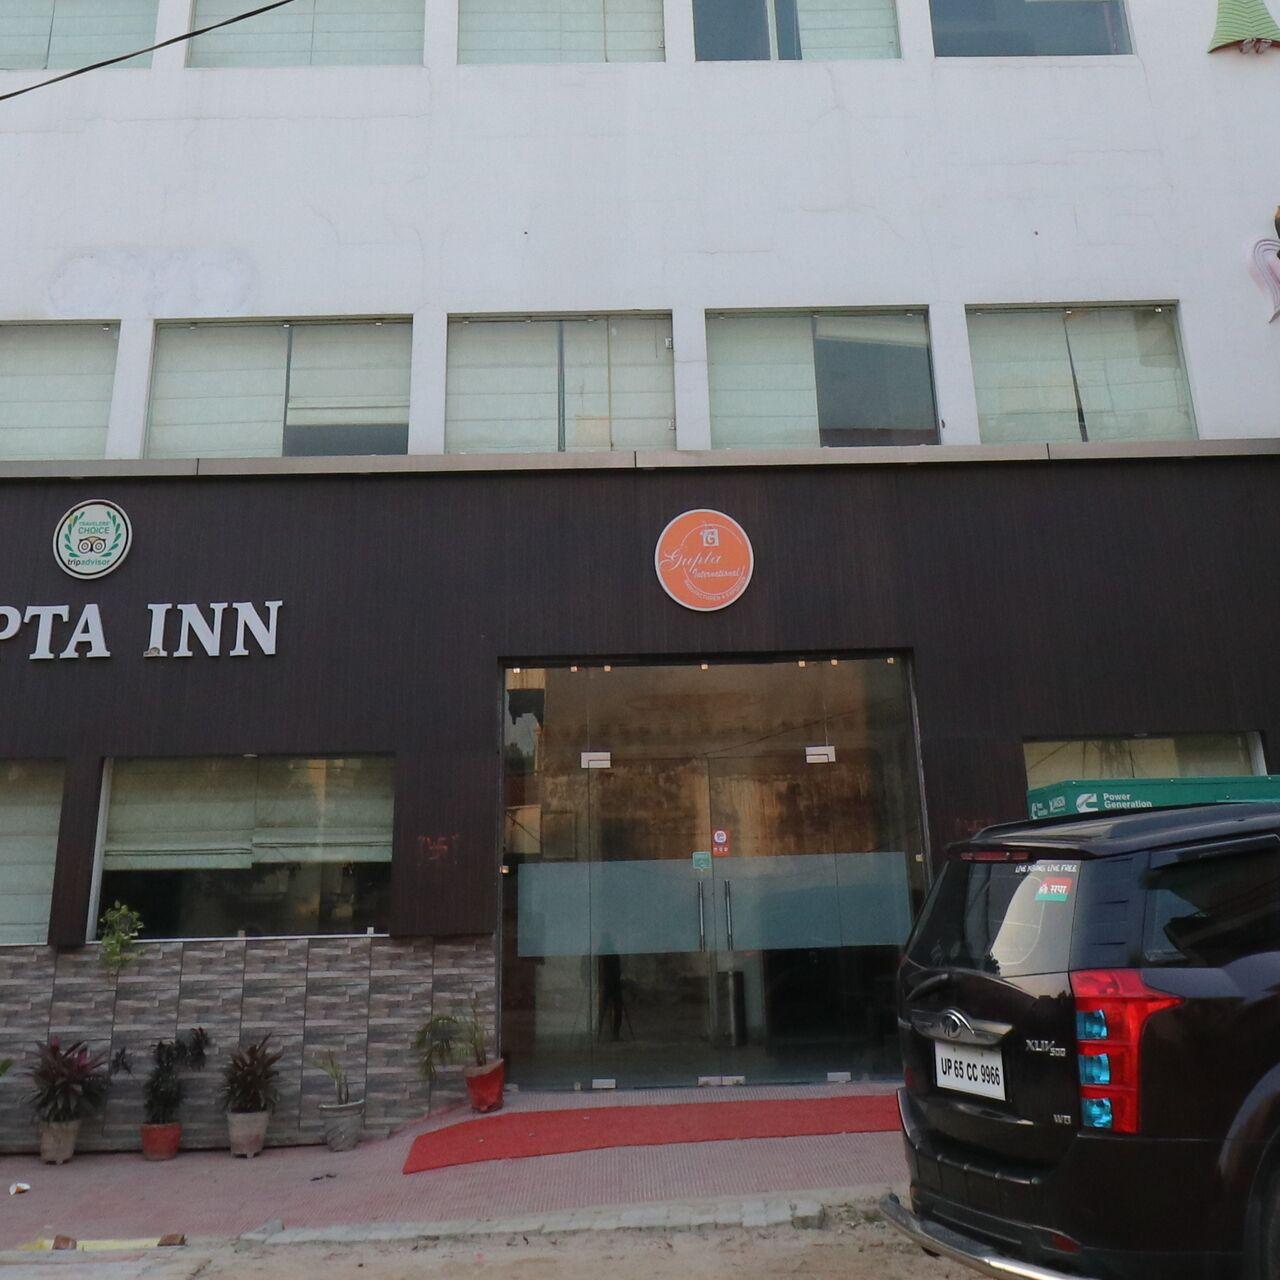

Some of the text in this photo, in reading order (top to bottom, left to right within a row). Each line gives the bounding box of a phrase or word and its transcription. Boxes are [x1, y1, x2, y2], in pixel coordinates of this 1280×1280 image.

[78, 526, 111, 535] CHOICE
[67, 559, 111, 567] tripadvisor
[660, 548, 724, 574] Gupta
[143, 599, 283, 659] INN
[1103, 792, 1131, 801] Power
[1104, 799, 1153, 810] Generation
[941, 1057, 1001, 1086] UP 65 CC 9966
